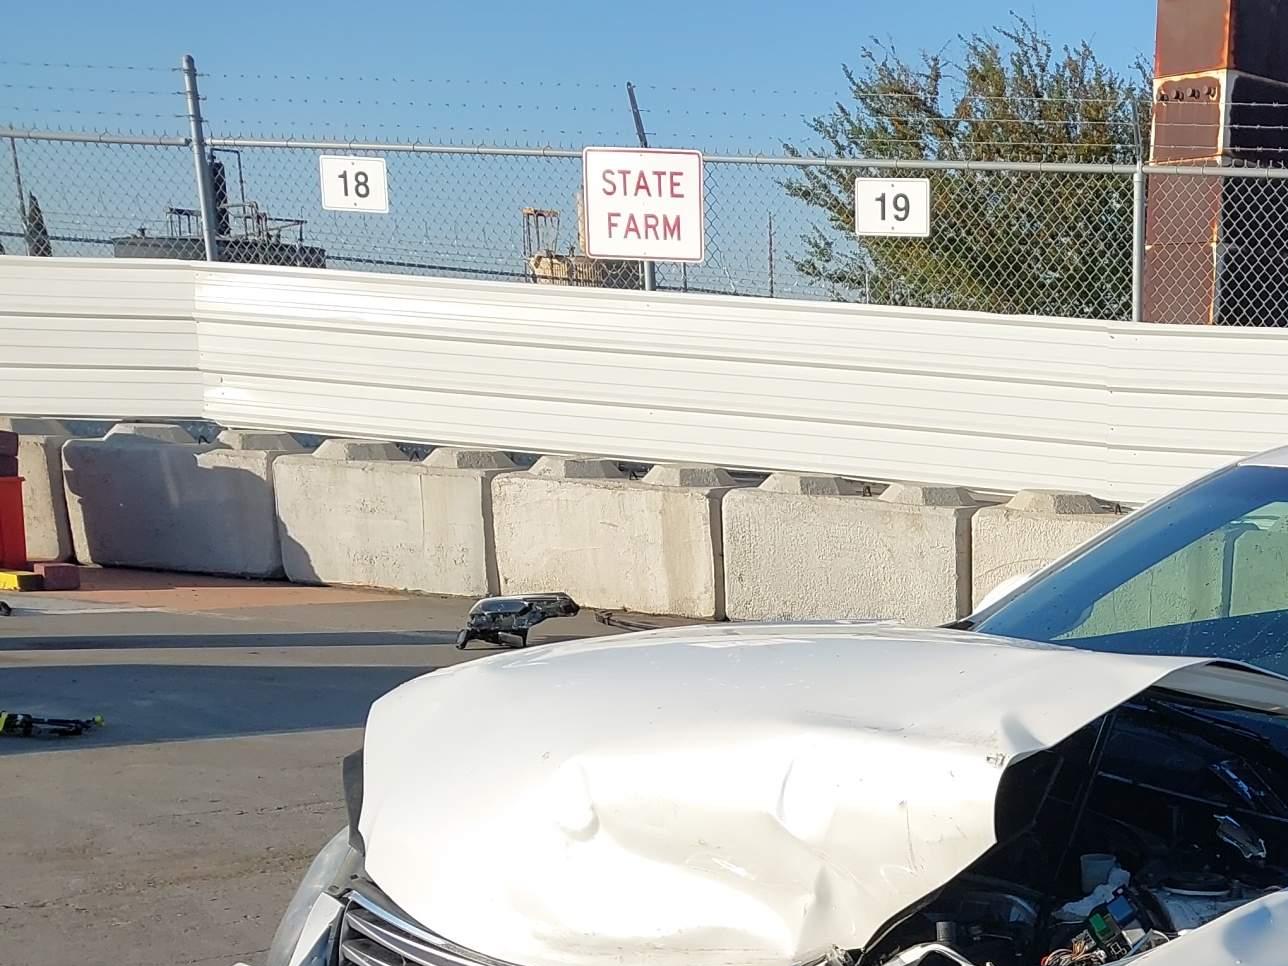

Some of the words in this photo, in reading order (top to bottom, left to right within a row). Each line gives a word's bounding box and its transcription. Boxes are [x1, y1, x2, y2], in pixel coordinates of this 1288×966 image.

[337, 170, 370, 198] 18
[602, 169, 685, 199] STATE
[874, 192, 910, 222] 19
[607, 212, 681, 241] FARM
